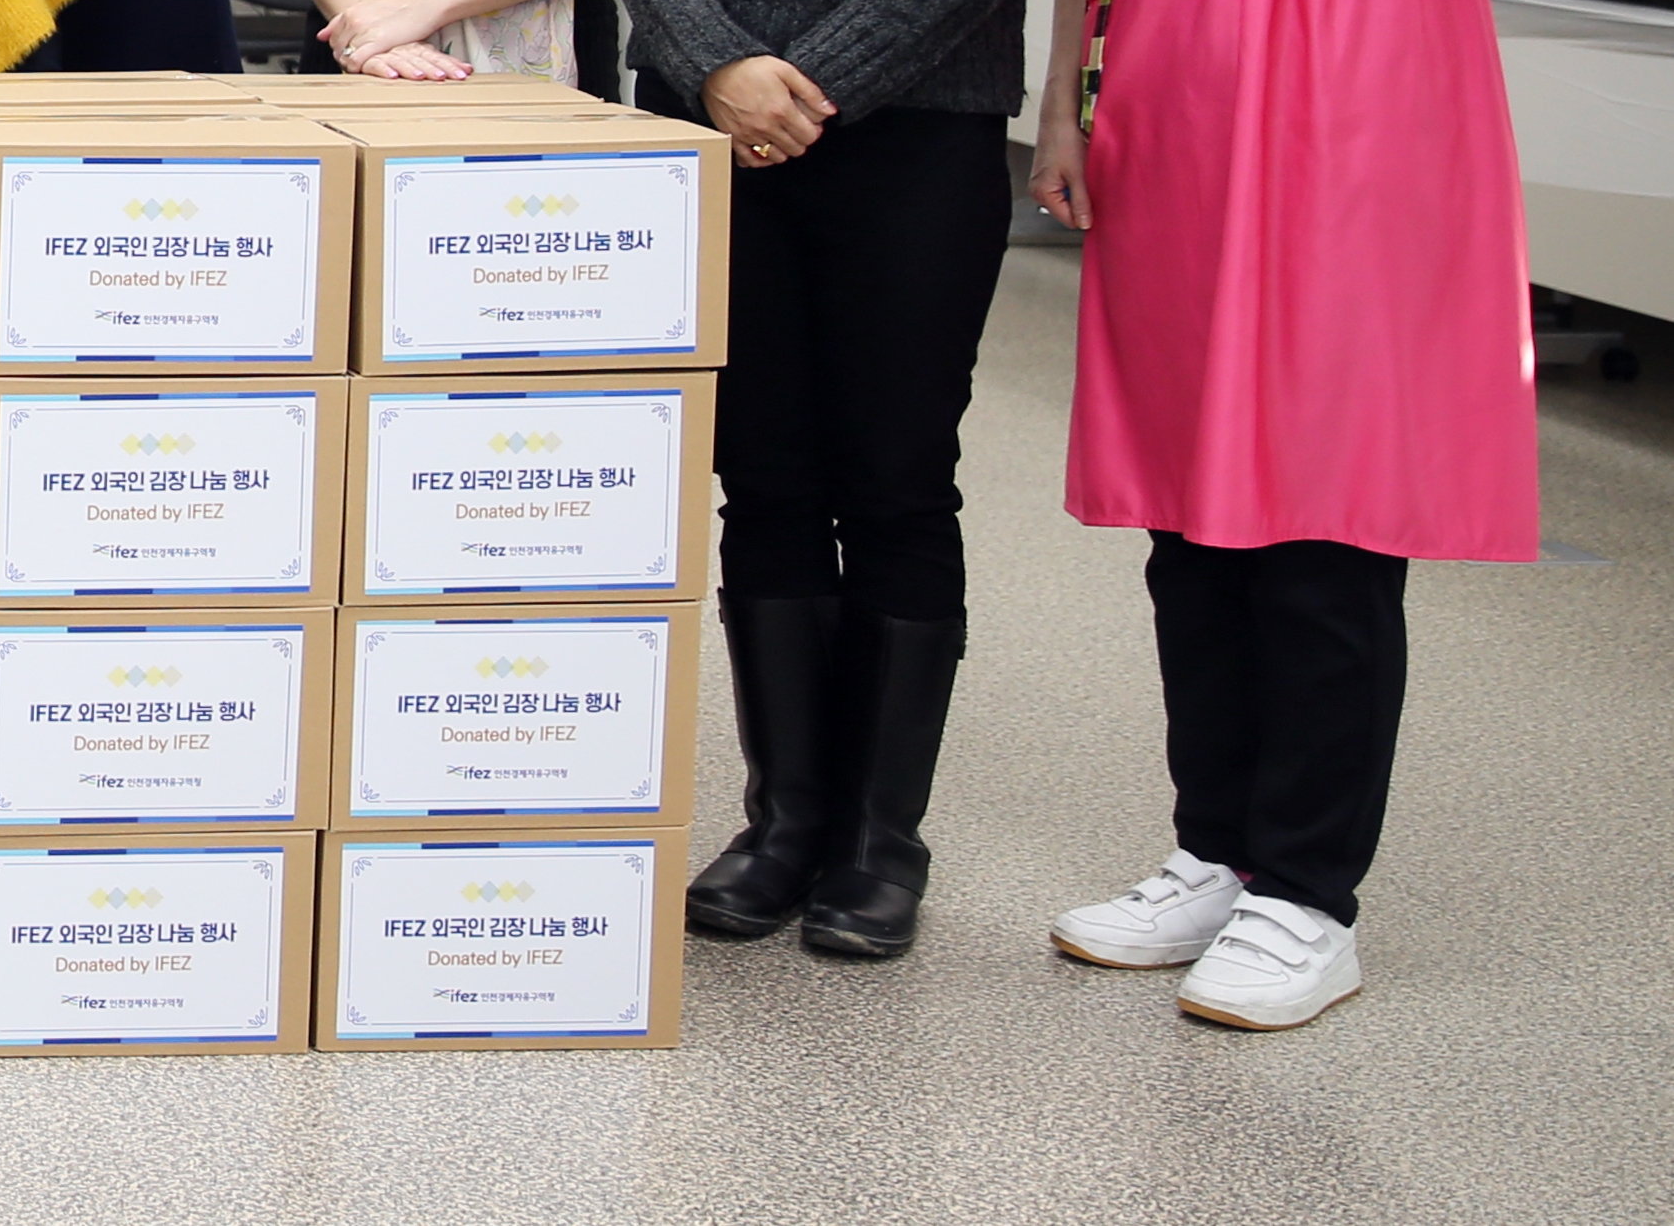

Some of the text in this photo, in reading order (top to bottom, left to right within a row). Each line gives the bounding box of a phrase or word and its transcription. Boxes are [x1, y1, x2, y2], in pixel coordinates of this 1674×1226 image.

[42, 470, 271, 492] IFEZ 외국인 김장 나눔 행사
[86, 504, 225, 523] Donated by IFEZ
[397, 693, 623, 714] IFEZ 외국인 김장 나눔 행사
[440, 726, 578, 744] Donated by IFEZ
[384, 917, 610, 938] IFEZ 외국인 김장 나눔 행사
[427, 950, 564, 968] Donated by IFEZ
